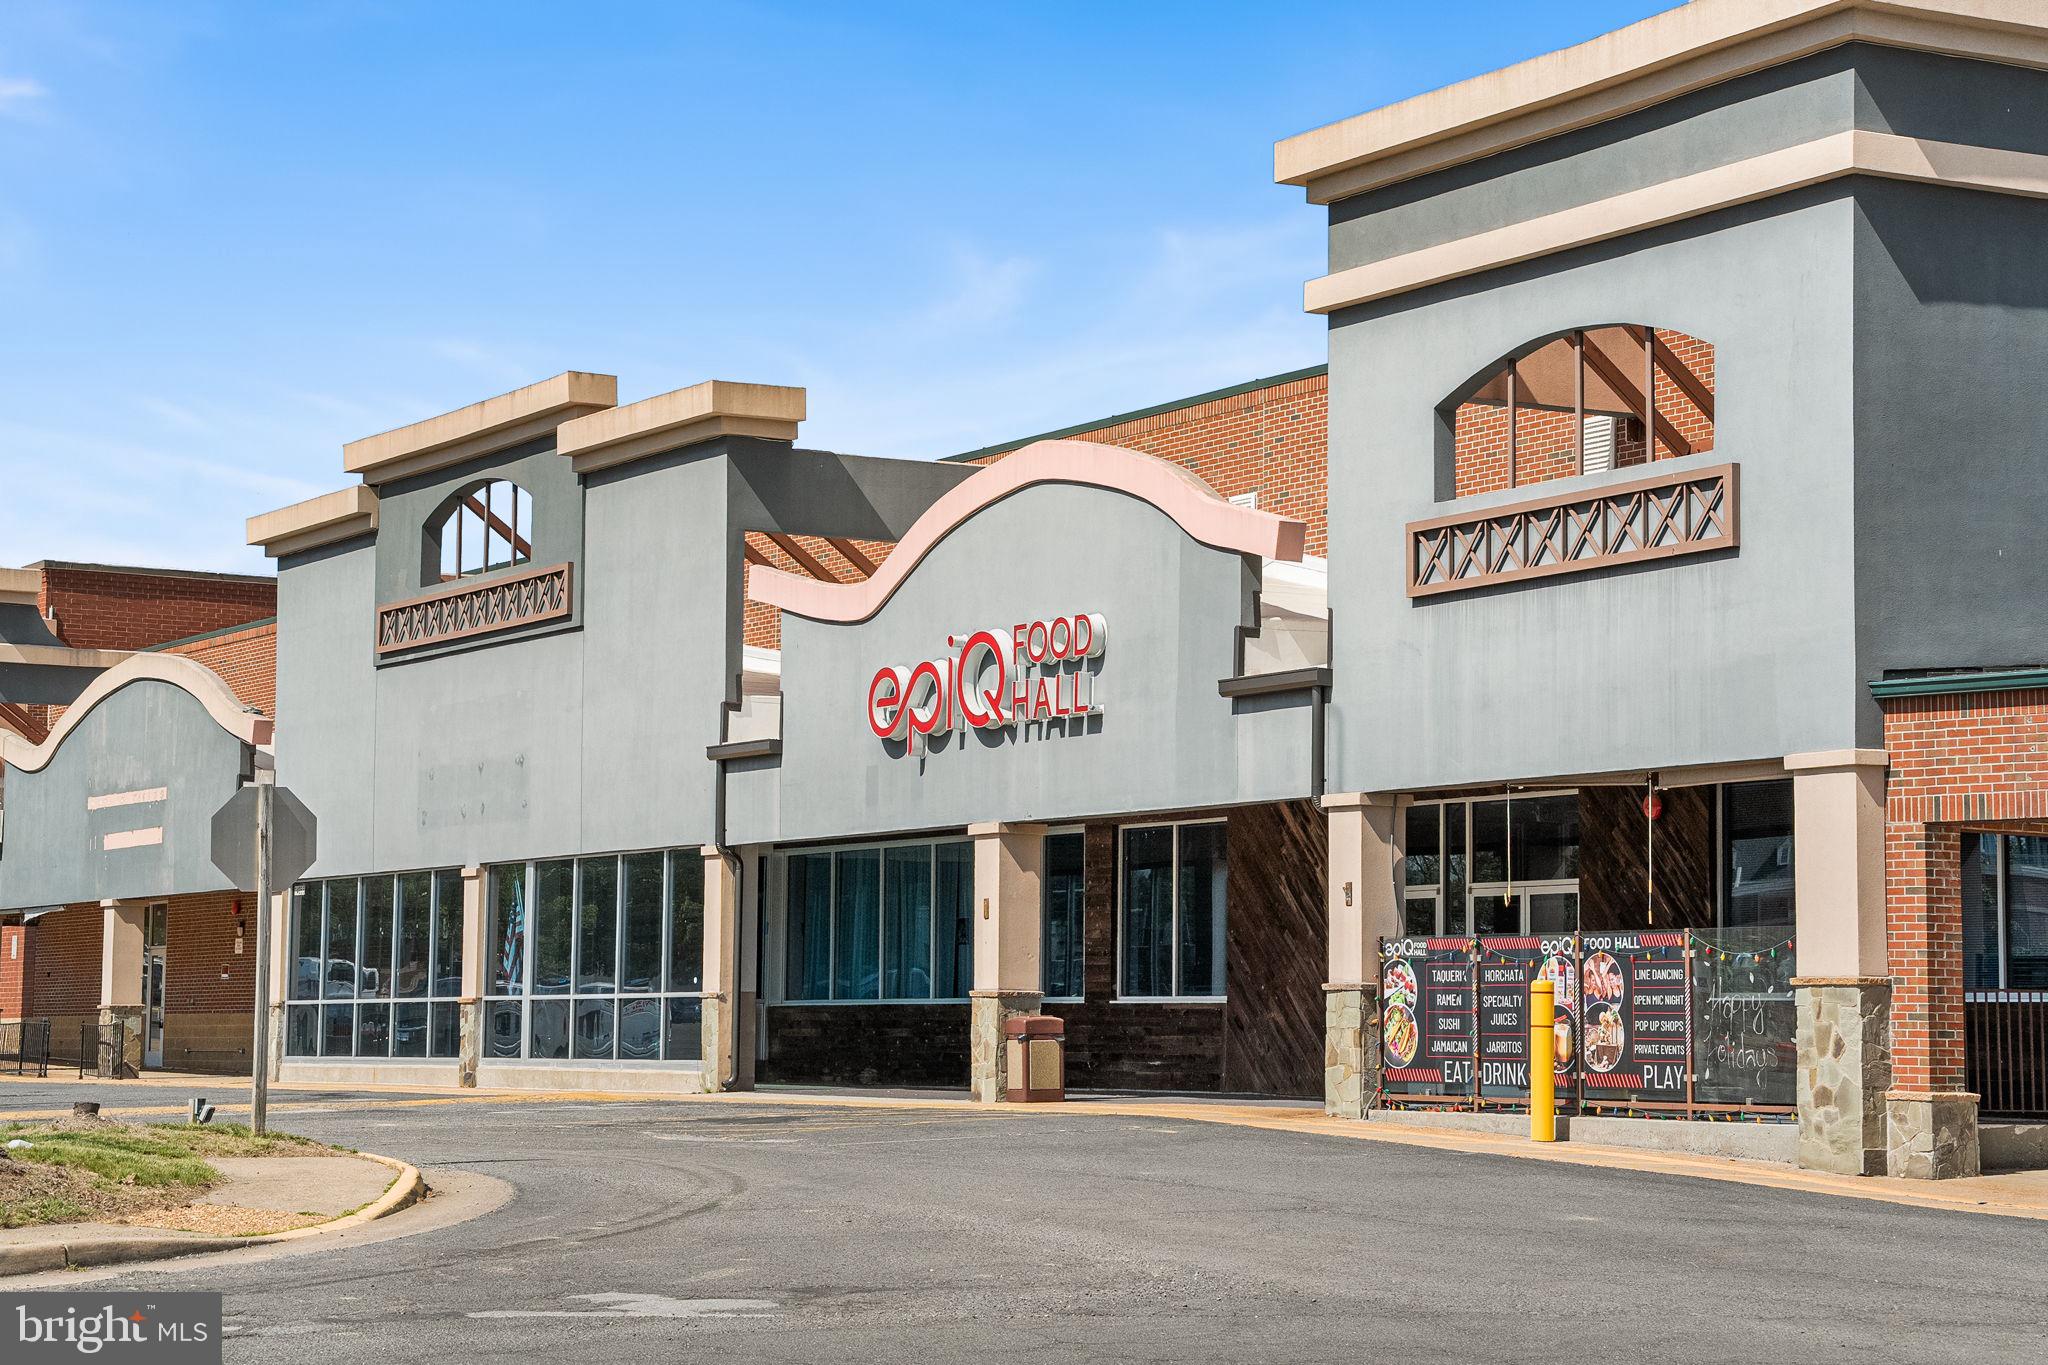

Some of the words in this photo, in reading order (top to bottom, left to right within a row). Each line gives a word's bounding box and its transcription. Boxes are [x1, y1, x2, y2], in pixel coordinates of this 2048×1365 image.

[1013, 614, 1095, 666] FOOD
[867, 630, 1006, 757] epiQ
[1012, 671, 1090, 722] HALL
[1414, 941, 1427, 949] FOOD
[1584, 937, 1612, 950] FOOD
[1614, 936, 1641, 949] HALL
[1485, 969, 1524, 982] HORCHATA
[1634, 969, 1651, 980] LINE
[1651, 969, 1684, 980] DANCING
[1436, 994, 1462, 1006] RAMEN
[1483, 995, 1523, 1007] SPECIALTY
[1634, 995, 1651, 1005] OPEN
[1652, 995, 1664, 1005] MIC
[1664, 995, 1684, 1005] NIGHT
[1438, 1017, 1460, 1030] SUSHI
[1490, 1013, 1518, 1026] JUICES
[1635, 1020, 1649, 1031] POP
[1649, 1020, 1660, 1031] UP
[1660, 1020, 1684, 1032] SHOPS
[1431, 1040, 1468, 1053] JAMAICAN
[1486, 1041, 1523, 1053] JARRITOS
[1634, 1044, 1660, 1054] PRIVATE
[1660, 1044, 1685, 1055] EVENTS
[1444, 1061, 1471, 1083] EAT
[1483, 1062, 1527, 1086] DRINK
[1643, 1064, 1684, 1089] PLAY
